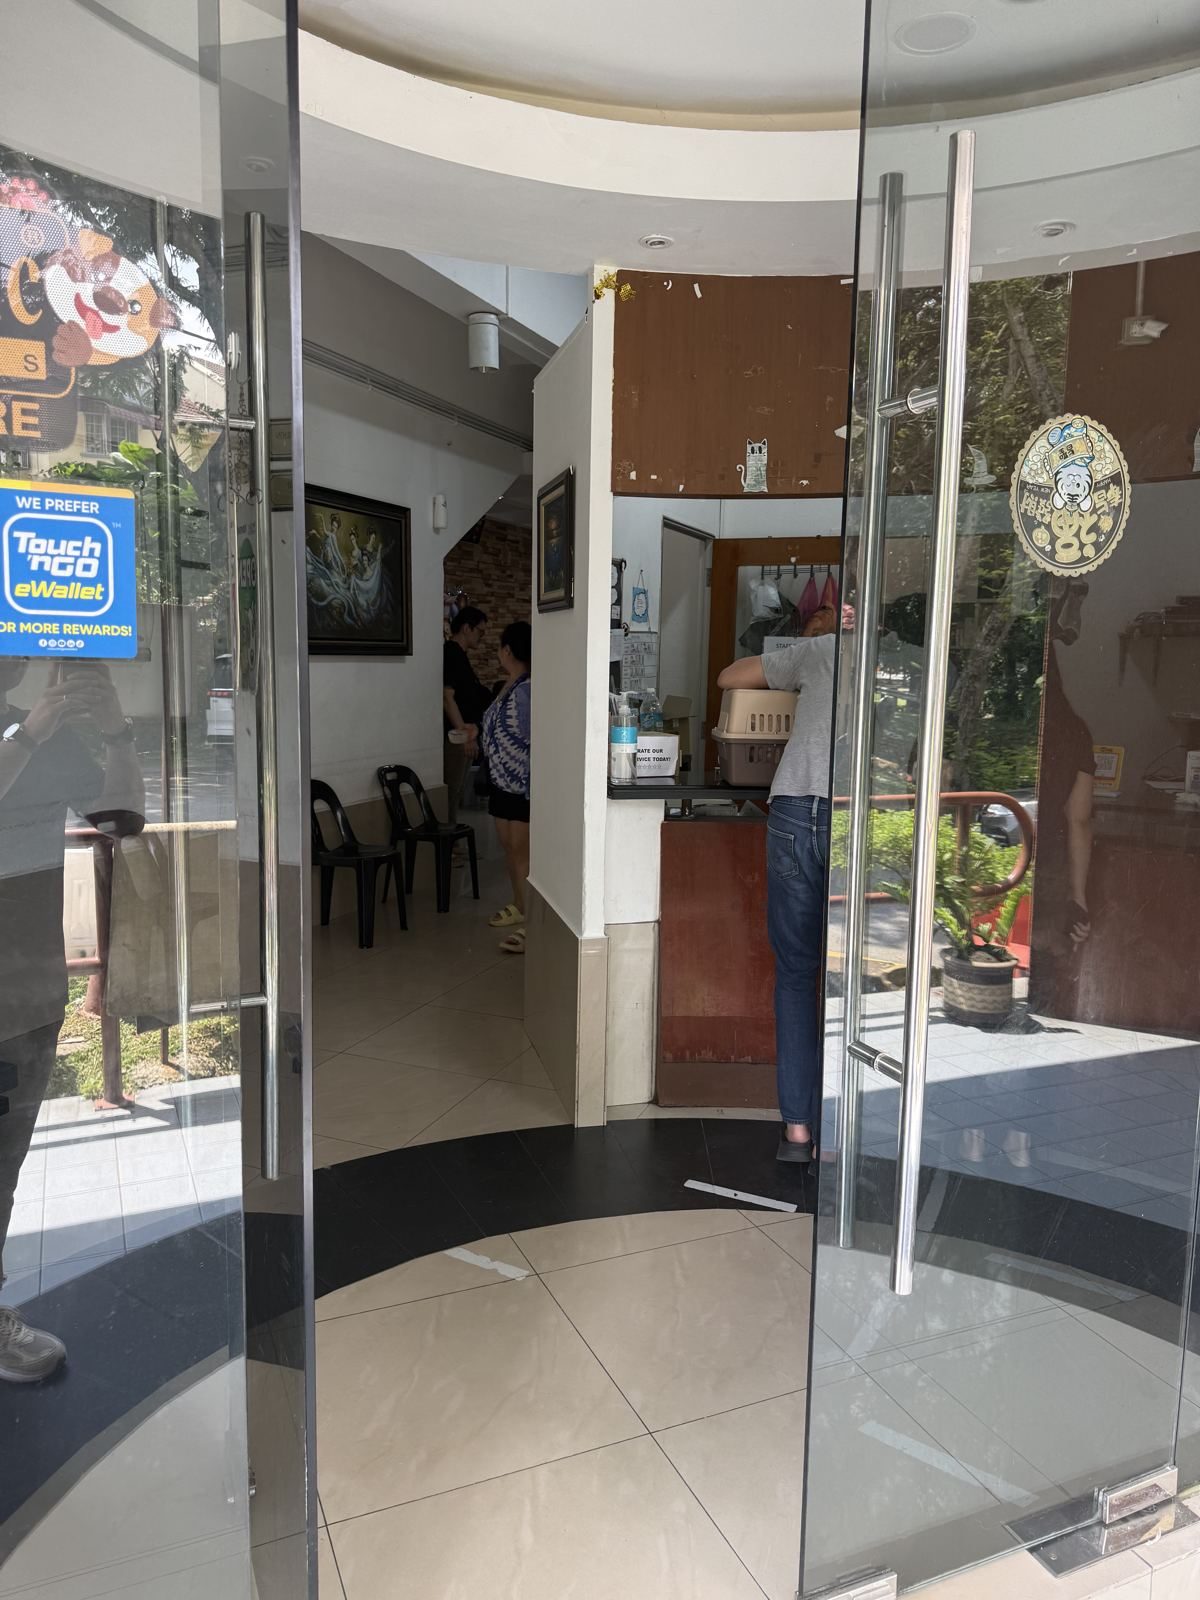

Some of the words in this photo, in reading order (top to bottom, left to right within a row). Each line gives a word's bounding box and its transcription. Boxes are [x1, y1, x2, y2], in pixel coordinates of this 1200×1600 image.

[15, 495, 42, 510] WE
[45, 498, 100, 514] PREFER
[13, 531, 102, 558] Touch
[14, 580, 105, 600] eWallet
[20, 622, 60, 635] MORE
[63, 623, 133, 637] REWARDS!
